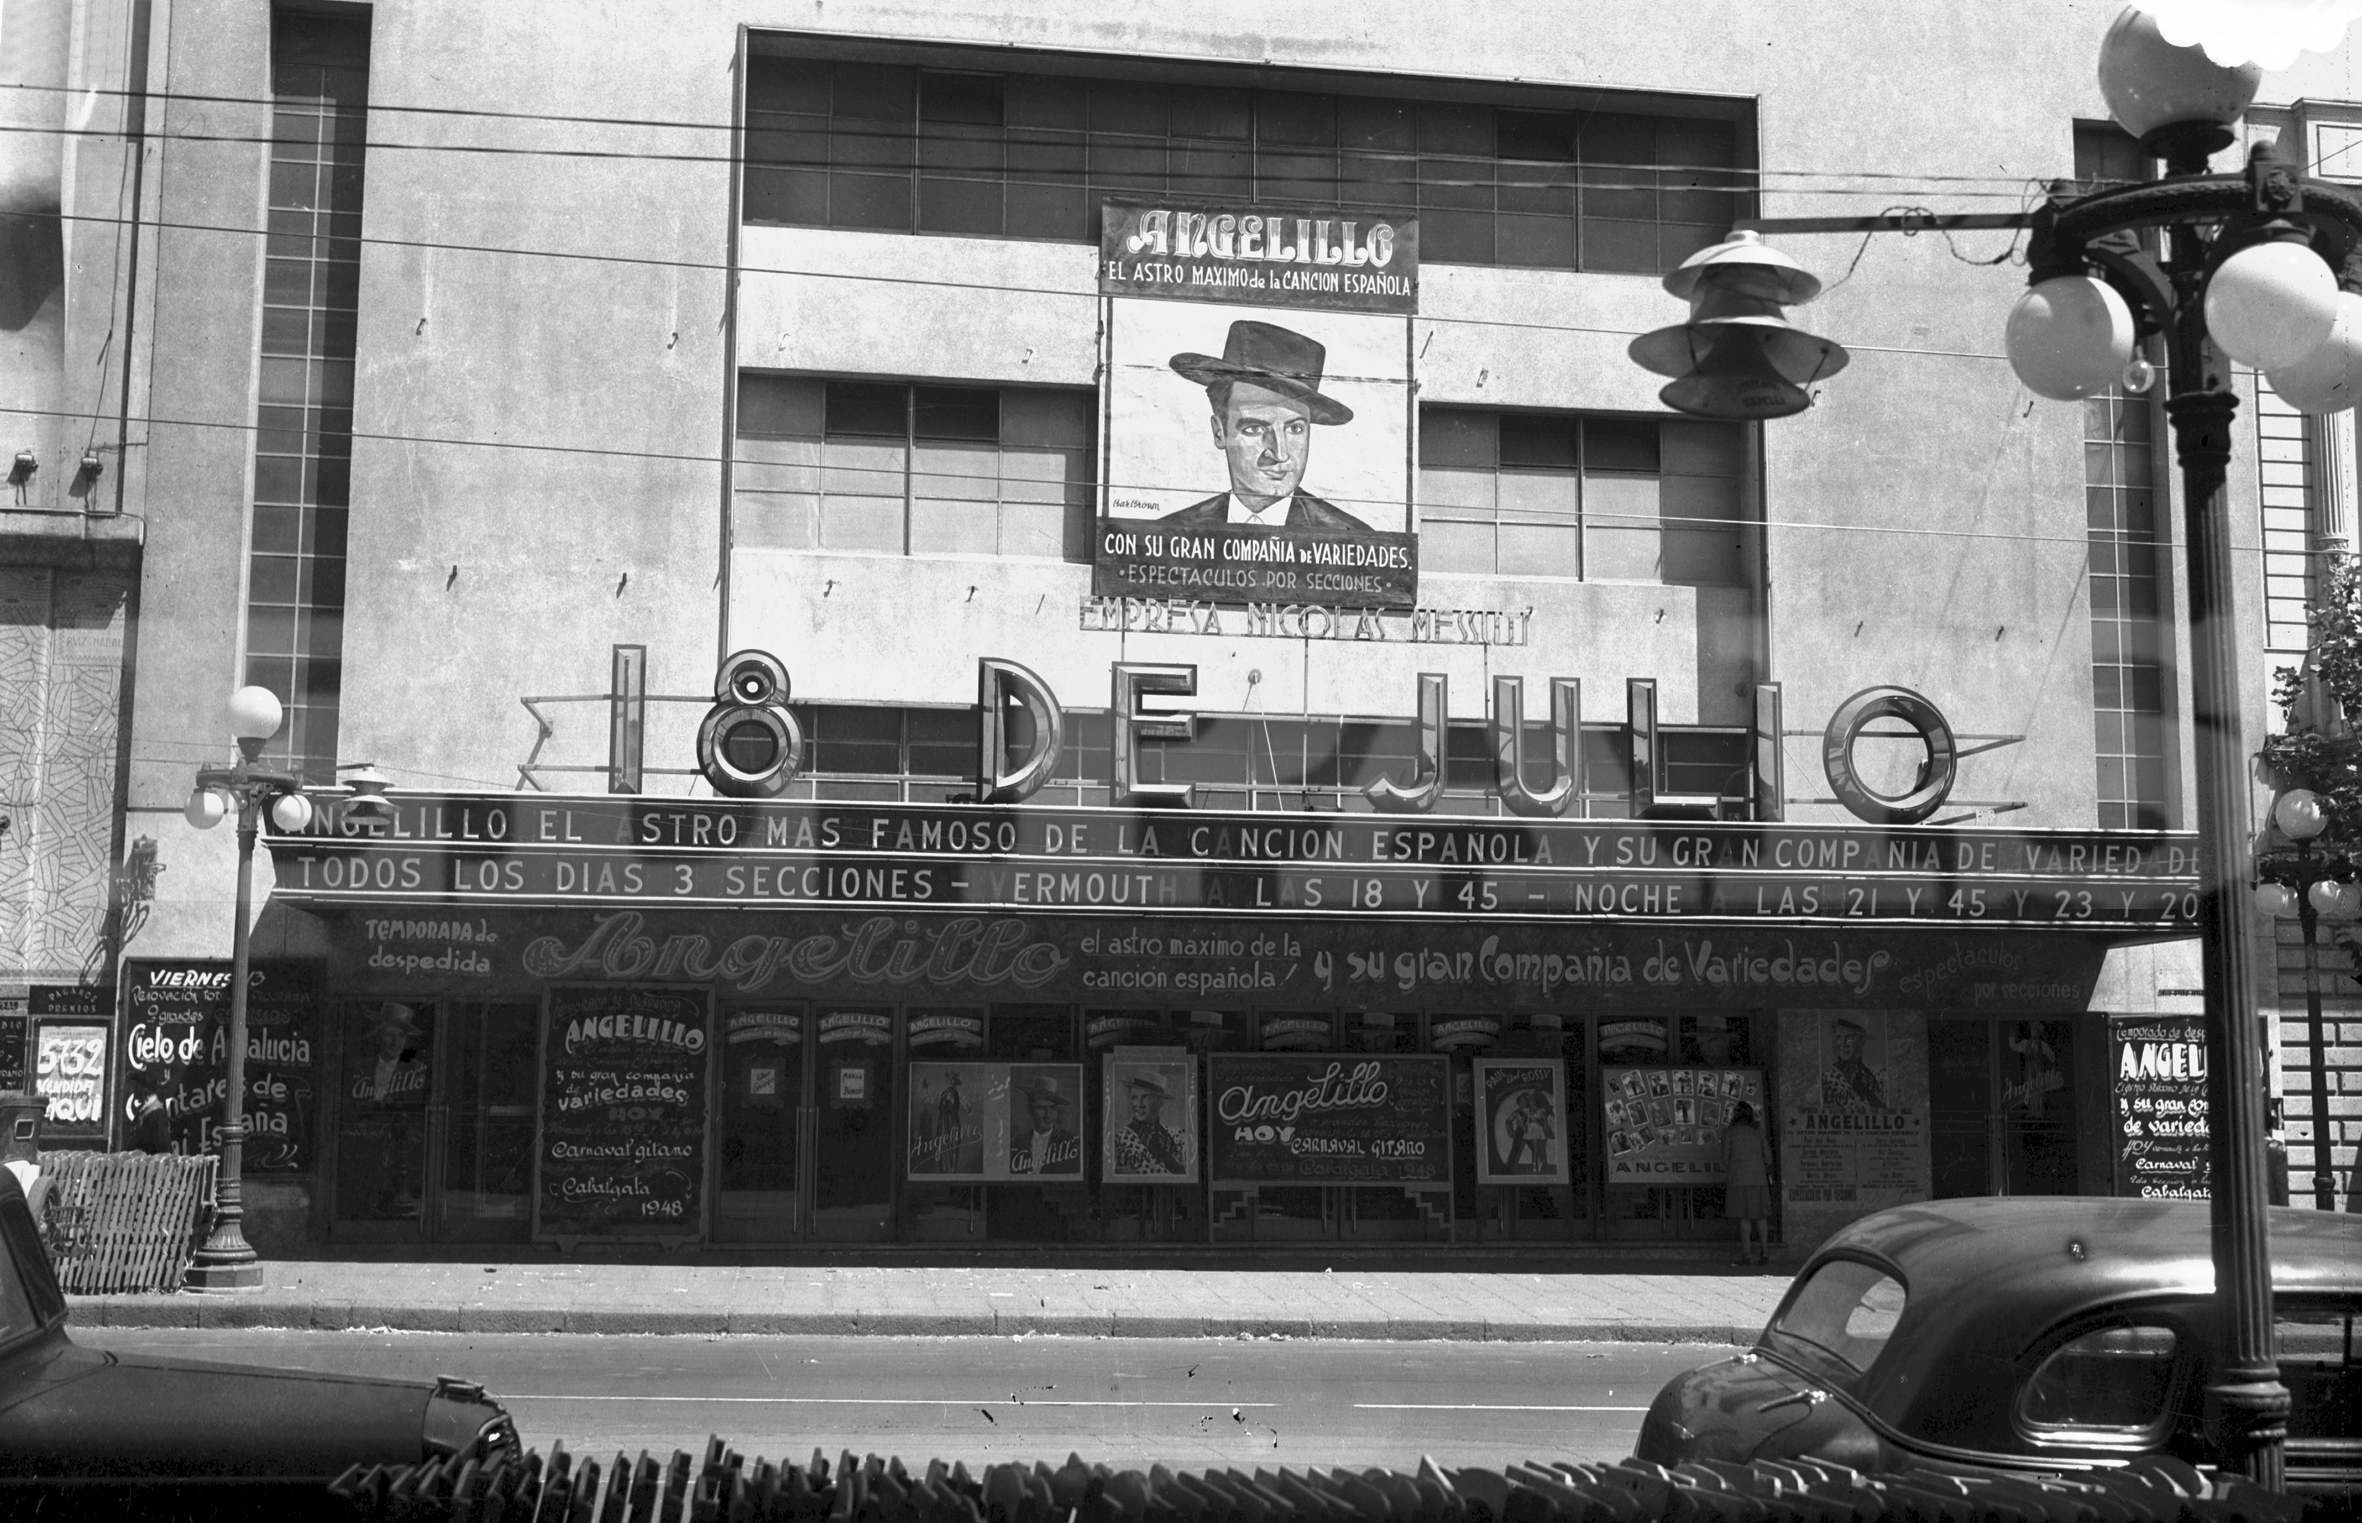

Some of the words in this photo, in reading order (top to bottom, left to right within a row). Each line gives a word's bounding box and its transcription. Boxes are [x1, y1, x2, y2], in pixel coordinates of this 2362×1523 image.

[1126, 209, 1394, 267] ANGELILLO
[1109, 261, 1127, 280] EL
[1133, 262, 1184, 284] ASTRO
[1192, 265, 1248, 287] MAXIMO
[1249, 274, 1266, 289] de
[1270, 269, 1281, 289] la
[1282, 270, 1339, 293] CANCION
[1344, 271, 1411, 297] ESPAÑOLA
[1104, 533, 1138, 555] CON
[1145, 534, 1163, 557] SU
[1170, 536, 1215, 560] GRAN
[1223, 536, 1295, 563] COMPAÑIA
[1128, 564, 1256, 588] ESPECTACULOS
[1266, 571, 1297, 589] POR
[1306, 572, 1383, 594] SECCIONES
[1080, 596, 1223, 637] EMPRESA
[1246, 602, 1386, 641] NICOLAS
[608, 643, 802, 798] 18
[976, 656, 1197, 806] DE
[1362, 672, 1958, 827] JULIO
[283, 803, 508, 841] NLILLO
[539, 810, 582, 842] EL
[614, 811, 737, 847] ASTRO
[766, 815, 841, 849] MAS
[871, 818, 1017, 852] FAMOSO
[1044, 823, 1088, 854] DE
[1117, 824, 1160, 856] LA
[1191, 827, 1343, 860] CANCION
[1582, 835, 1601, 865] Y
[1615, 836, 1657, 866] SU
[1672, 836, 1759, 868] GRAN
[1957, 842, 1997, 871] DE
[298, 856, 422, 891] TODOS
[454, 859, 525, 892] LOS
[556, 861, 644, 895] DIAS
[673, 863, 694, 895] 3
[725, 865, 933, 901] SECCIONES
[990, 869, 1177, 906] VERMOUTH
[1207, 876, 1226, 907] A
[1255, 877, 1323, 908] LAS
[1351, 879, 1383, 909] 18
[1412, 880, 1432, 910] Y
[1457, 881, 1498, 911] 45
[1575, 883, 1683, 914] NOCHE
[1709, 885, 1727, 914] A
[1757, 885, 1820, 916] LAS
[1847, 887, 1877, 917] 21
[1906, 888, 1923, 916] Y
[1947, 888, 1987, 917] 45
[2013, 889, 2030, 918] Y
[2055, 890, 2093, 919] 23
[2120, 891, 2136, 919] Y
[2160, 891, 2198, 920] 20
[365, 918, 472, 943] TEMPORADA
[475, 919, 499, 943] de
[1080, 928, 1101, 954] el
[1108, 927, 1164, 955] astro
[1250, 932, 1276, 957] de
[1283, 932, 1302, 958] la
[368, 946, 491, 975] despedida
[522, 911, 1071, 993] Angelillo
[150, 969, 233, 987] VIERNES
[1313, 950, 1333, 993] y
[1346, 949, 1386, 984] su
[1394, 947, 1474, 995] gran
[1643, 938, 1682, 986] de
[1684, 937, 1891, 997] Variedades
[1974, 980, 1999, 1007] por
[2000, 980, 2080, 1001] secciones
[564, 1013, 706, 1055] ANGELILLO
[730, 1013, 799, 1028] ANGELILLO
[821, 1014, 886, 1029] ANGELILLO
[910, 1017, 972, 1034] ANGELILLO
[2168, 1026, 2181, 1039] de
[127, 1022, 176, 1070] Cielo
[178, 1025, 206, 1064] de
[211, 1024, 312, 1067] Aalucia
[253, 1072, 290, 1102] de
[1218, 1061, 1389, 1122] Angelillo
[1485, 1069, 1507, 1089] PAUL
[1521, 1069, 1551, 1083] ROSSY
[557, 1082, 690, 1112] variedades
[2119, 1097, 2129, 1117] y
[2133, 1096, 2153, 1113] su
[2155, 1098, 2186, 1118] gran
[198, 1101, 289, 1153] Esaña
[607, 1106, 666, 1121] HOY
[1805, 1115, 1905, 1130] ANGELILLO
[2123, 1115, 2143, 1137] de
[1234, 1124, 1296, 1144] HOY
[1291, 1137, 1366, 1155] CARNAVAL
[1370, 1139, 1426, 1158] GITANO
[551, 1138, 635, 1160] Carnaval
[634, 1139, 693, 1165] gitano
[2135, 1155, 2199, 1170] Carnaval
[1300, 1158, 1390, 1180] Cabalgata
[1398, 1163, 1437, 1177] 1948
[561, 1176, 651, 1204] Cabalgata
[641, 1199, 684, 1218] 1948
